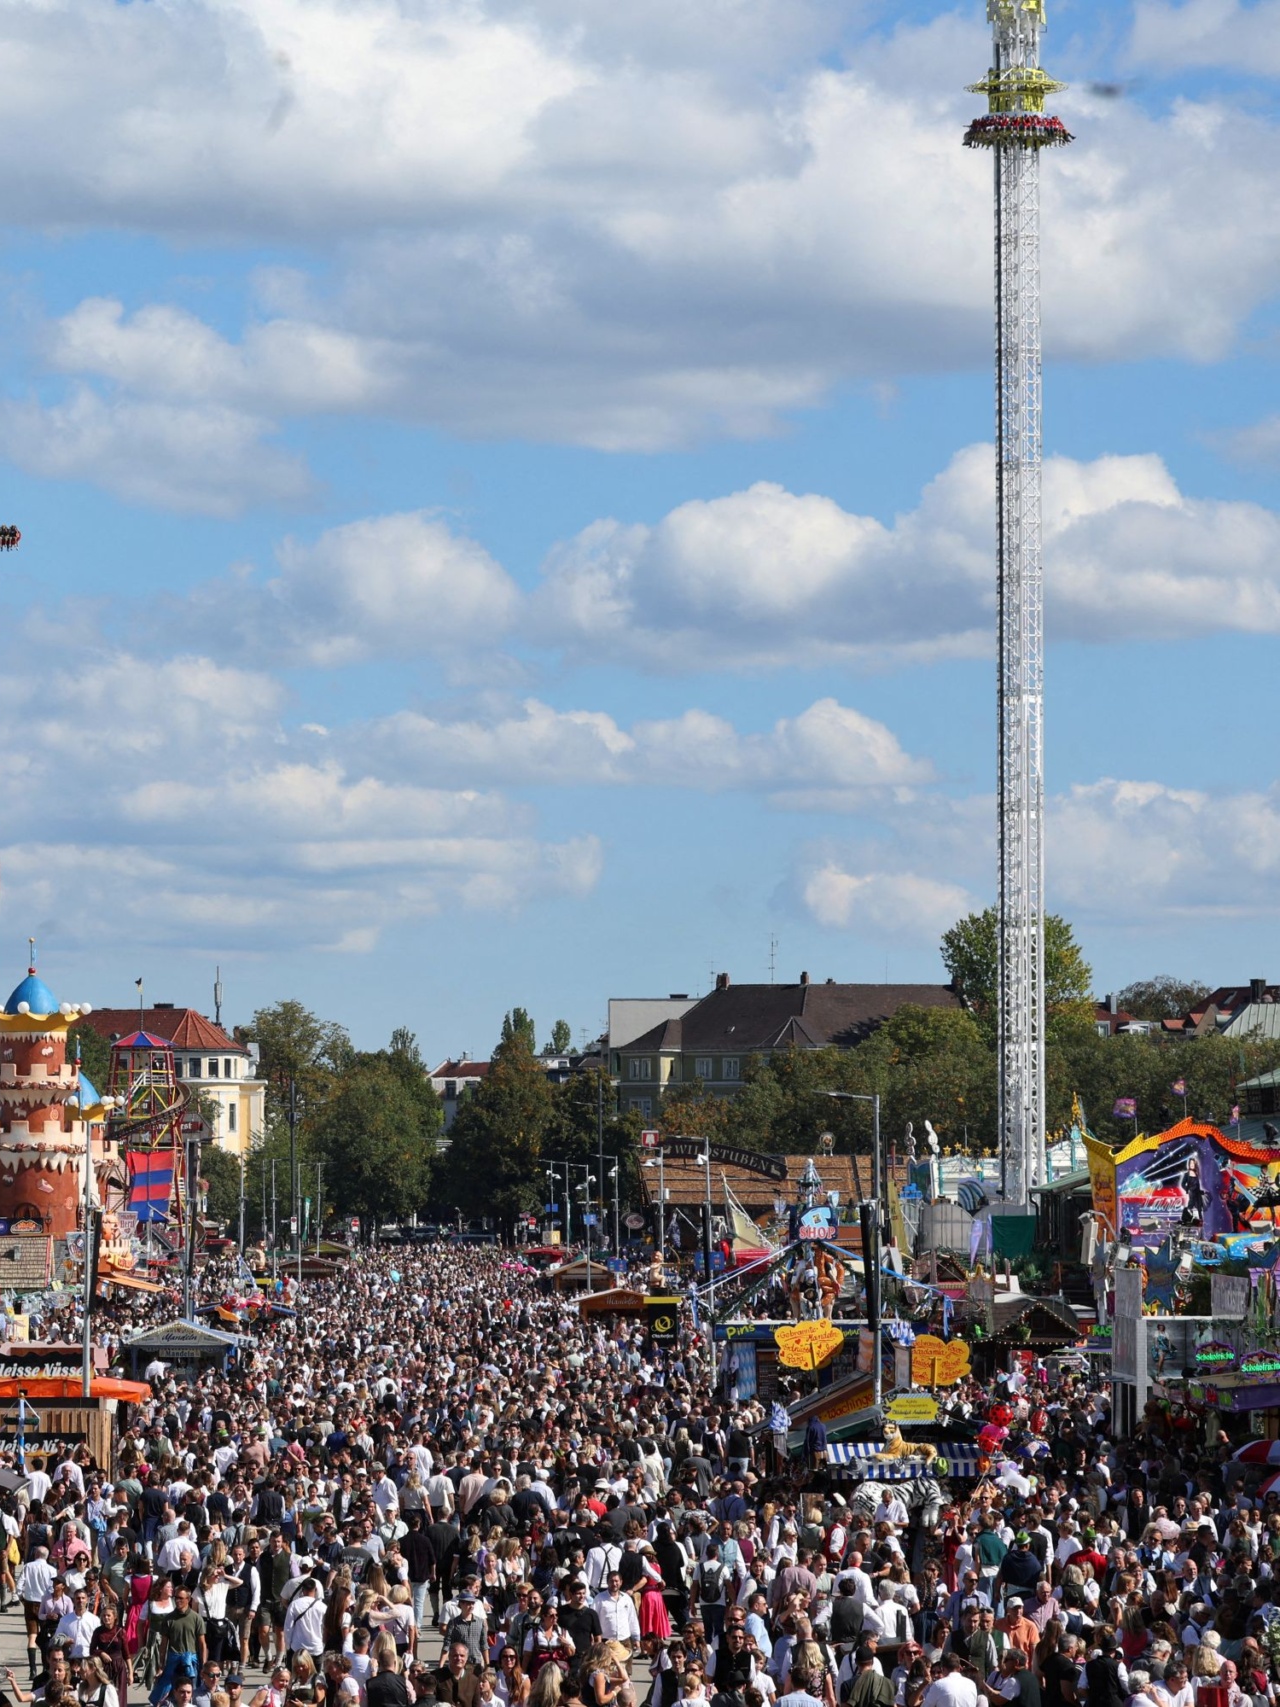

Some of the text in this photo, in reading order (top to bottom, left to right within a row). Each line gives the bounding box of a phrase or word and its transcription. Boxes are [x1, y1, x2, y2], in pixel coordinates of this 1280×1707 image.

[799, 1225, 836, 1239] SHOP
[162, 1333, 197, 1341] Mandeln
[725, 1323, 756, 1340] Pins
[42, 1361, 84, 1377] Nüsse
